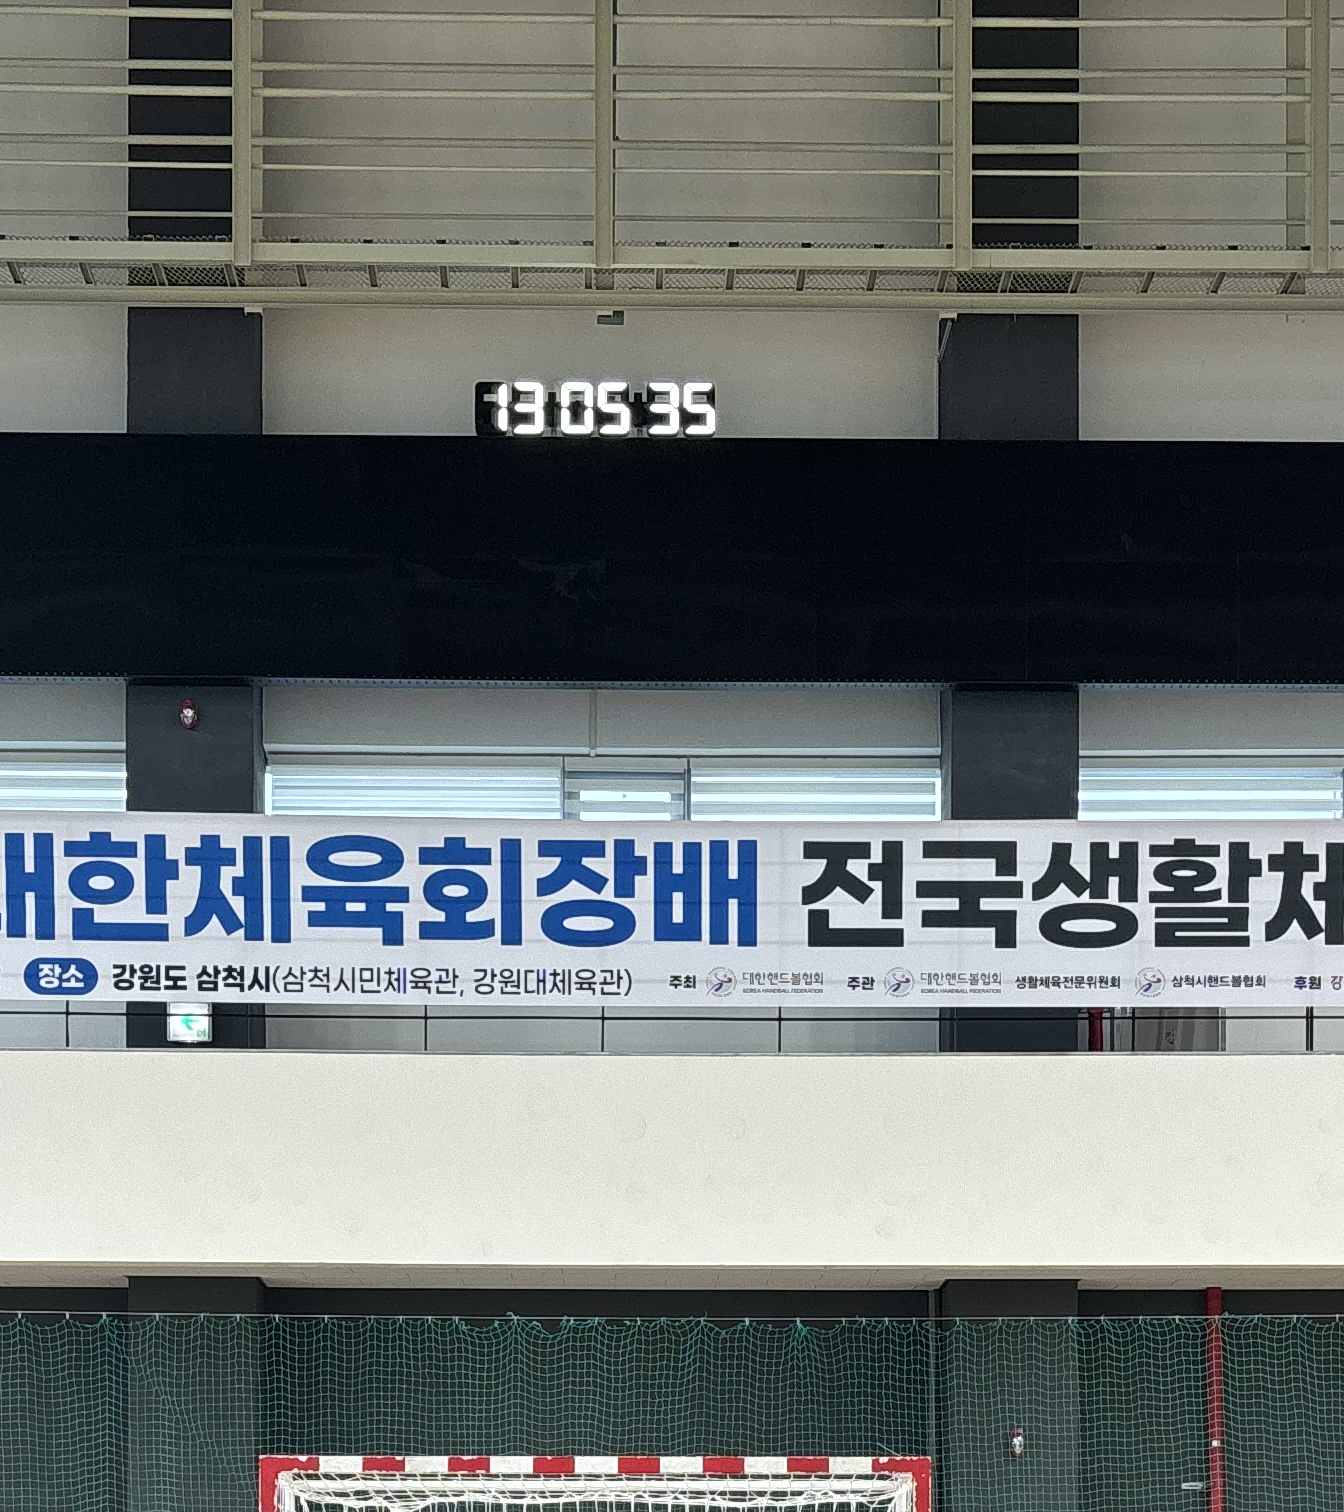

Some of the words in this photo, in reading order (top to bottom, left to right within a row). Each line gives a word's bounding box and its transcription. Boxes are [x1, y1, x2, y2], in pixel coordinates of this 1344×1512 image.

[37, 965, 85, 988] 장소
[112, 963, 188, 992] 강원도
[196, 964, 465, 996] 삼척시(삼척시민체육관,
[473, 967, 633, 997] 강원대체육관)
[669, 975, 697, 989] 주최
[742, 972, 824, 986] 대한핸드볼협회
[847, 976, 875, 991] 주관
[920, 972, 1002, 987] 대한핸드볼협회
[1015, 975, 1121, 990] 생활체육전문위원회
[1171, 974, 1267, 989] 삼척시핸드볼협회
[1294, 975, 1323, 990] 후원
